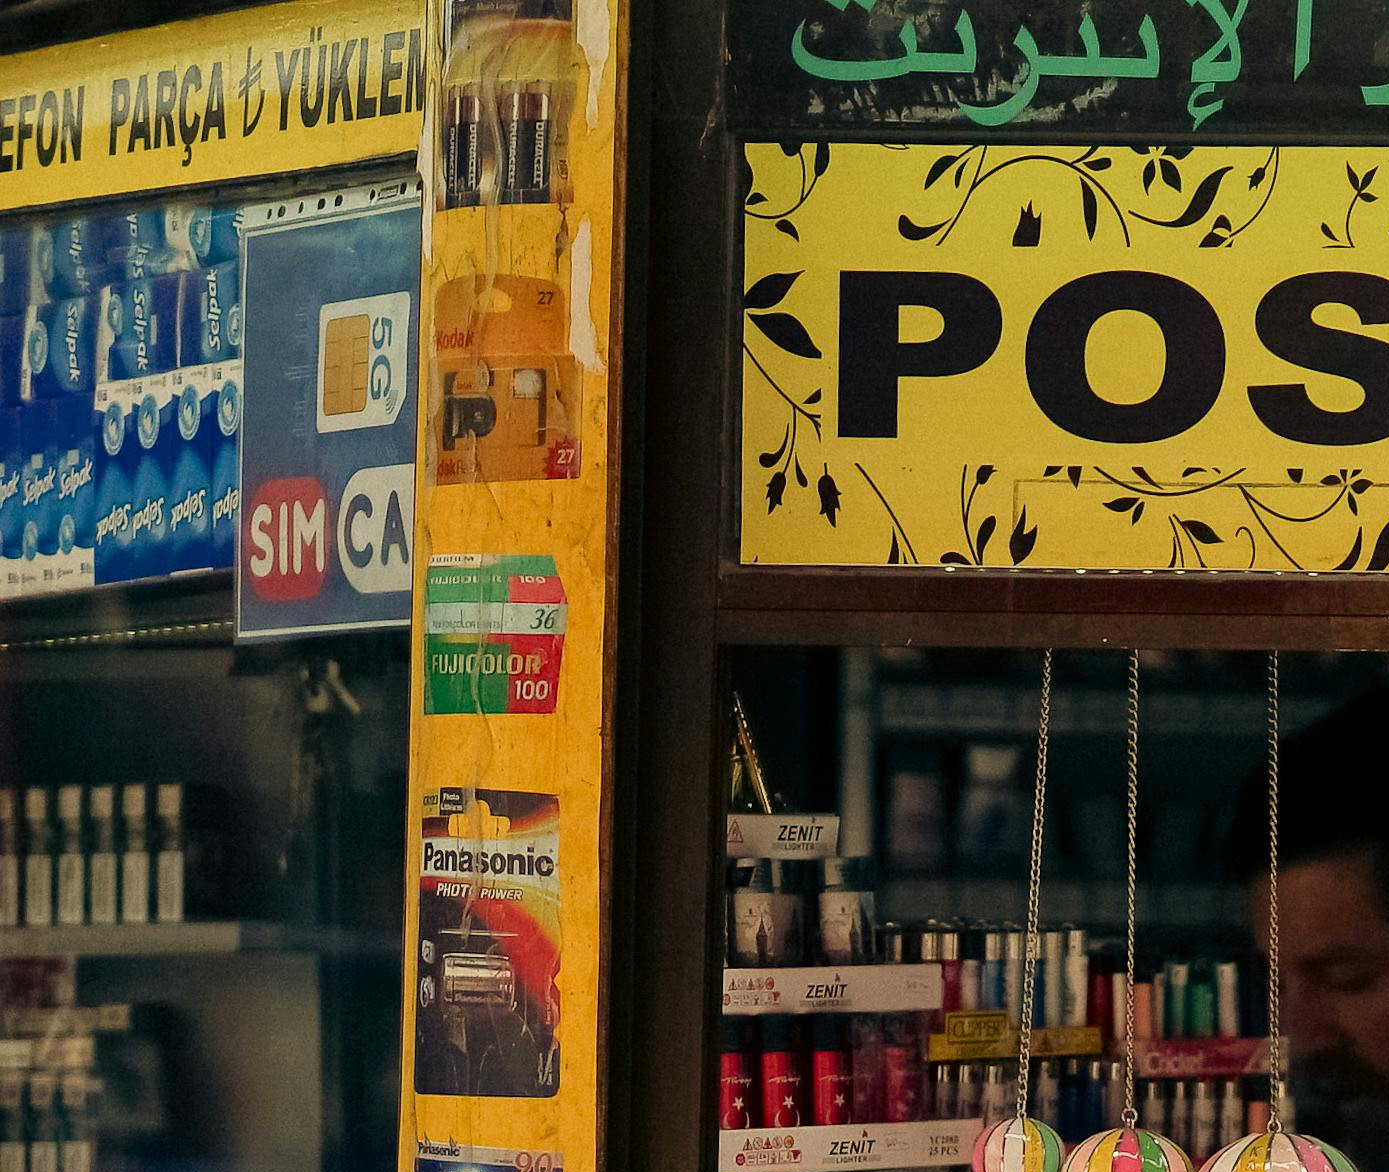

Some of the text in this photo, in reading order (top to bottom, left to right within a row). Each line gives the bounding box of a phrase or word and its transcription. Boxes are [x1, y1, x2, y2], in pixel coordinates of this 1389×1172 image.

[109, 61, 226, 167] PARÇA
[206, 268, 221, 351] Selpak
[369, 316, 393, 401] 5G
[556, 449, 576, 464] 27
[249, 497, 326, 578] SIM
[530, 608, 559, 630] 36
[515, 680, 549, 700] 100
[777, 824, 825, 843] ZENIT
[423, 842, 555, 877] Panasonic
[805, 983, 848, 999] ZENIT
[829, 1139, 876, 1156] ZENIT
